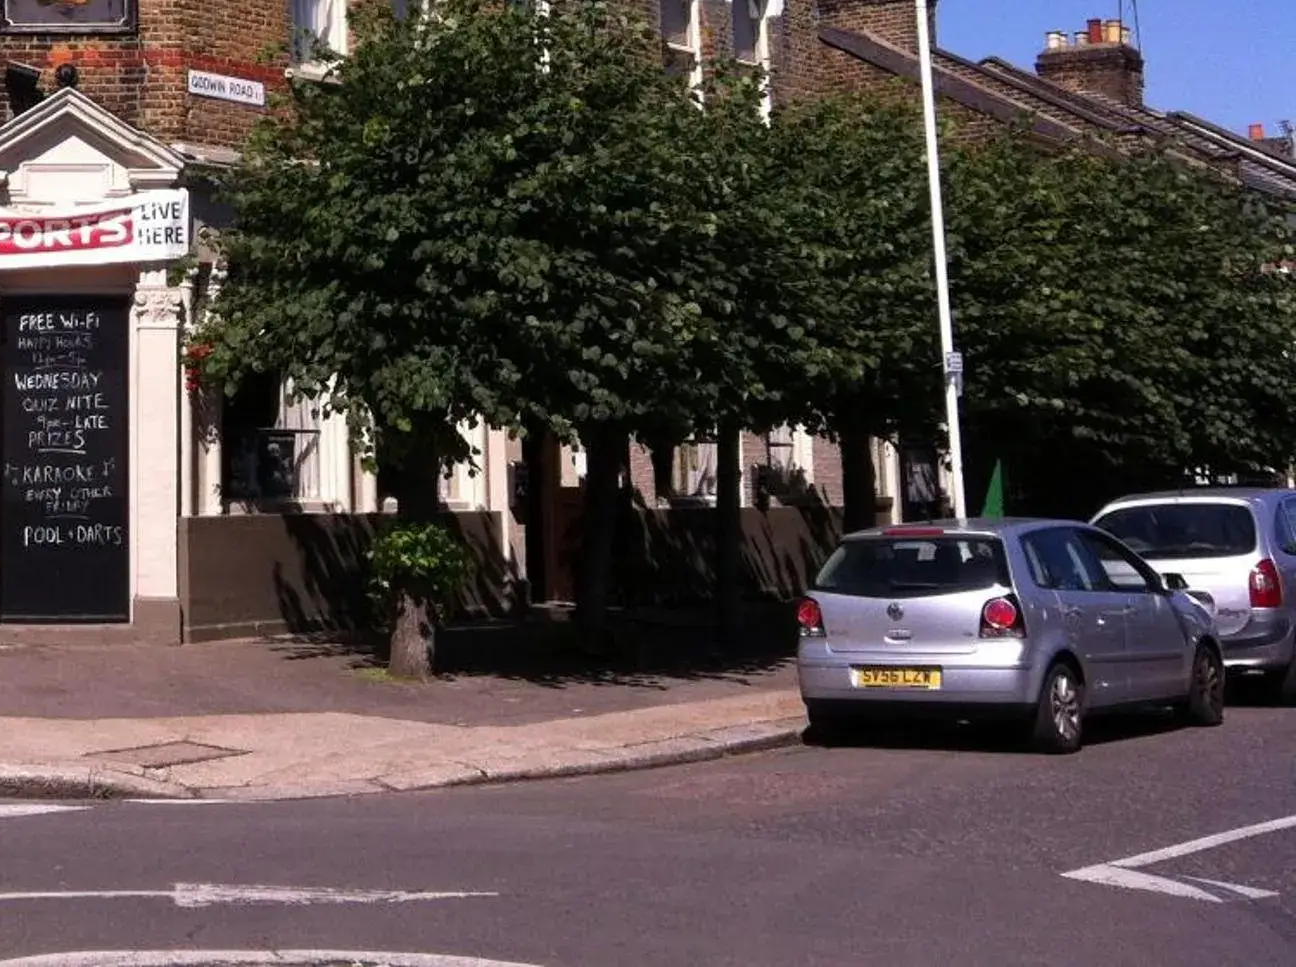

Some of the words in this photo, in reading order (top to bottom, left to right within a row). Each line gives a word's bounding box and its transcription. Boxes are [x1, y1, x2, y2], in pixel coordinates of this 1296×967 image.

[229, 81, 253, 98] ROAD
[141, 201, 181, 221] LIVE
[138, 224, 184, 245] HERE
[19, 313, 54, 331] FREE
[14, 372, 103, 390] WEDNESDAY
[22, 397, 59, 412] QUIZ
[65, 393, 110, 411] NITE
[29, 430, 85, 449] PRIZES
[23, 464, 93, 484] KARAOKE
[24, 525, 64, 547] POOL
[77, 522, 122, 545] DARTS
